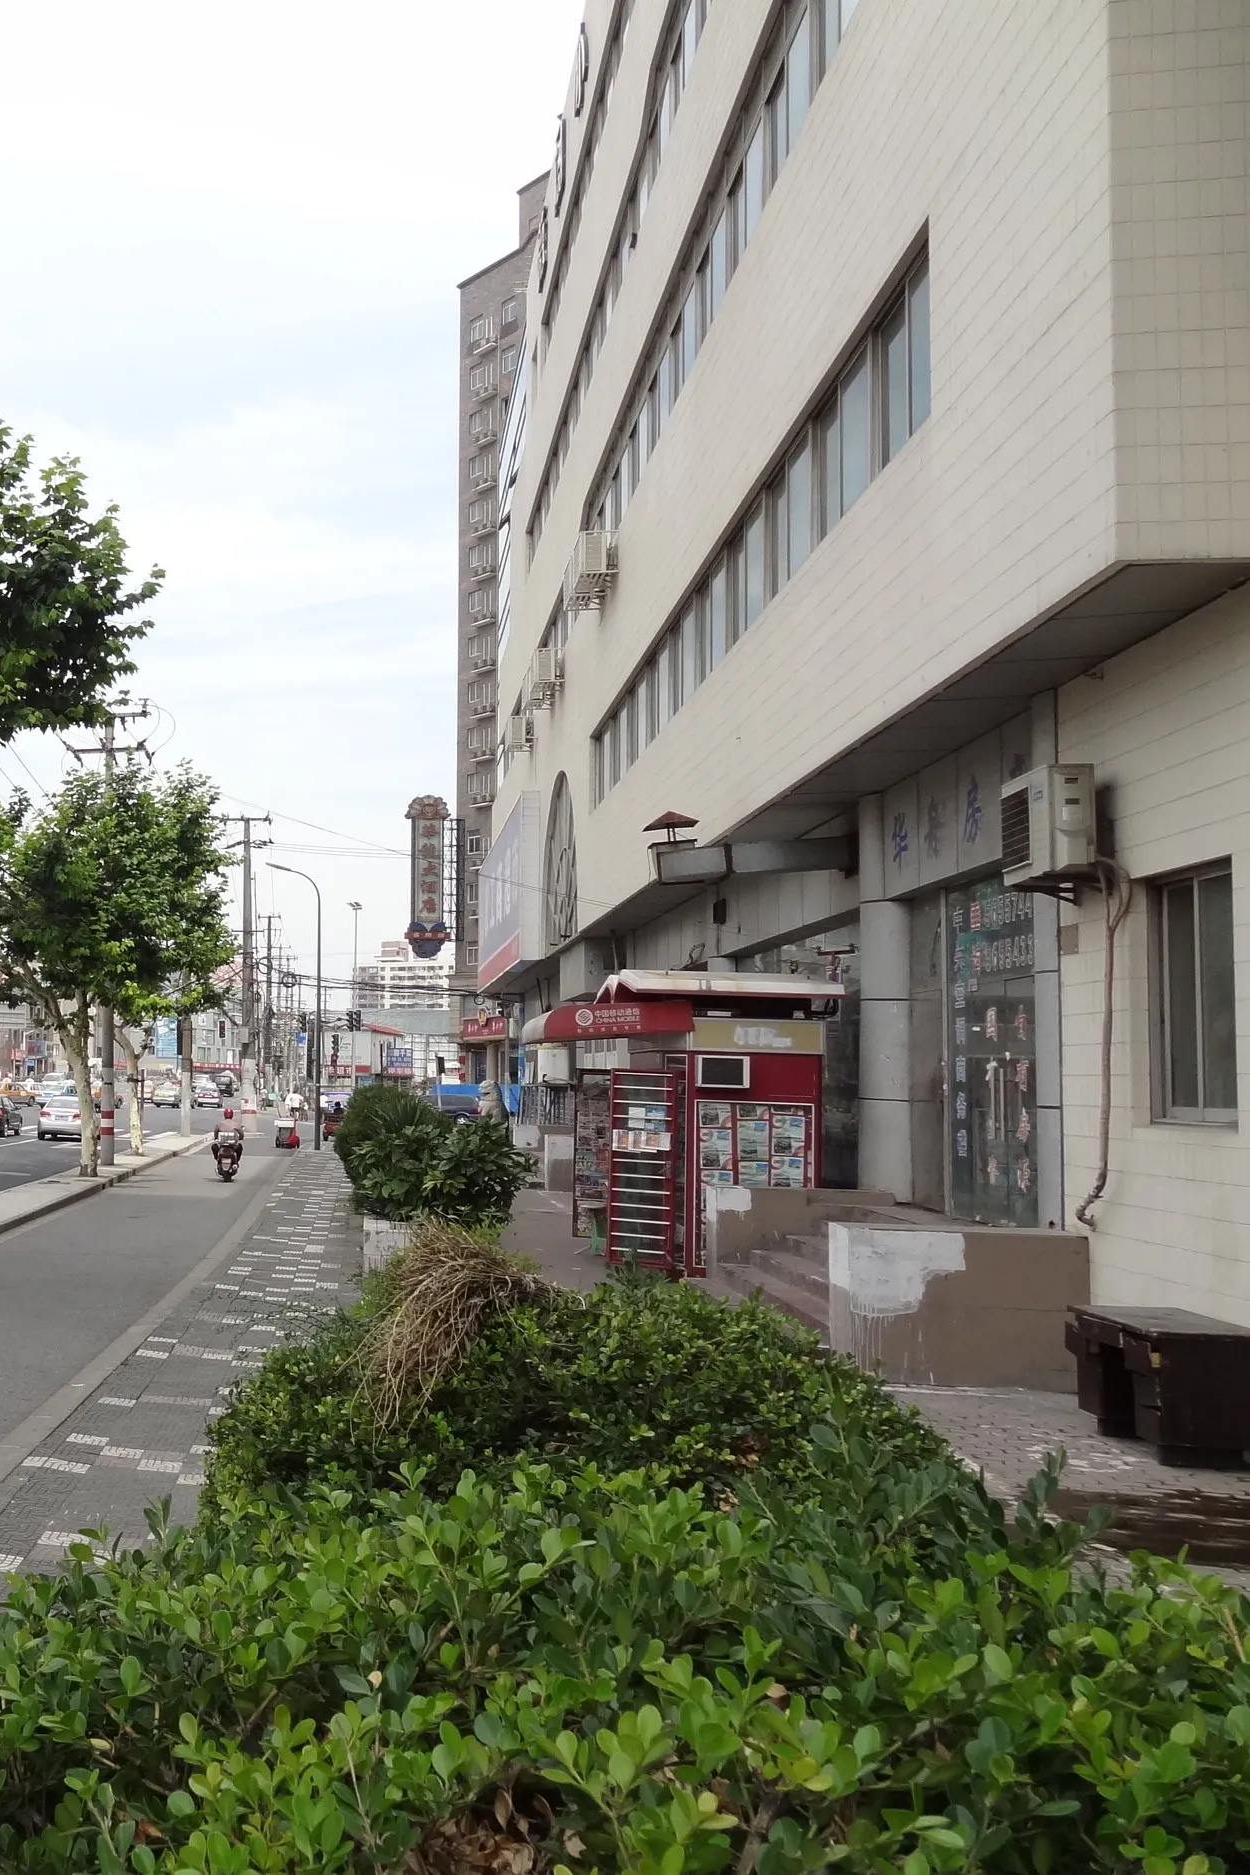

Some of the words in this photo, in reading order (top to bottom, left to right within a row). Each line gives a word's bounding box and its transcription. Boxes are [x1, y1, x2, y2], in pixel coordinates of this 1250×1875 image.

[594, 1007, 640, 1017] 中国移动通信
